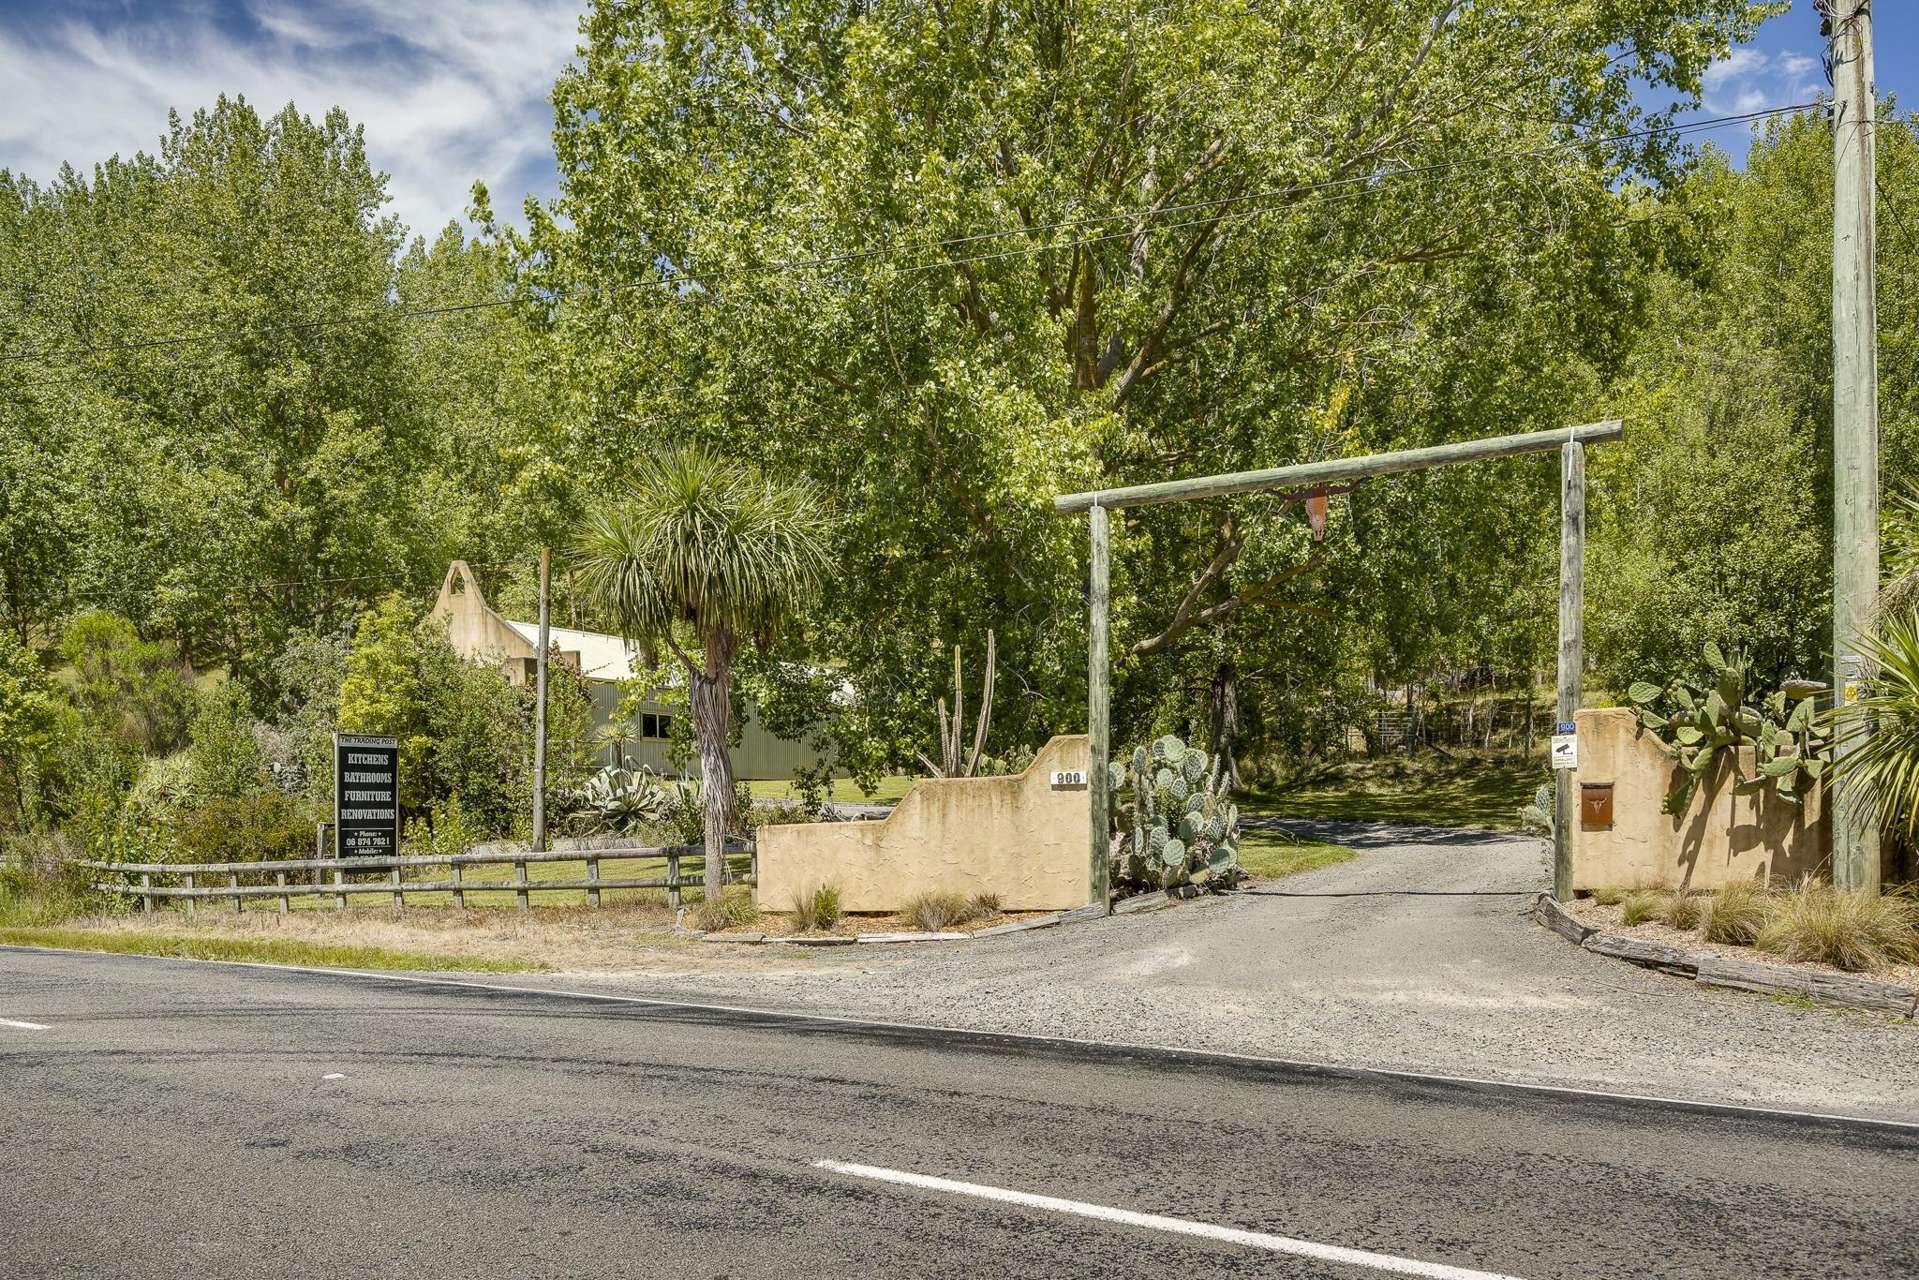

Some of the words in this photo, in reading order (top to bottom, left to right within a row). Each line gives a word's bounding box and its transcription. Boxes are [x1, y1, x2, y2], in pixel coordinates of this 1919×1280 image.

[1560, 722, 1574, 730] 900
[348, 754, 389, 765] KITCHENS
[344, 772, 392, 783] BATHROOMS
[1057, 772, 1080, 784] 900
[344, 791, 392, 801] FURNITURE
[341, 809, 395, 819] RENOVATIONS
